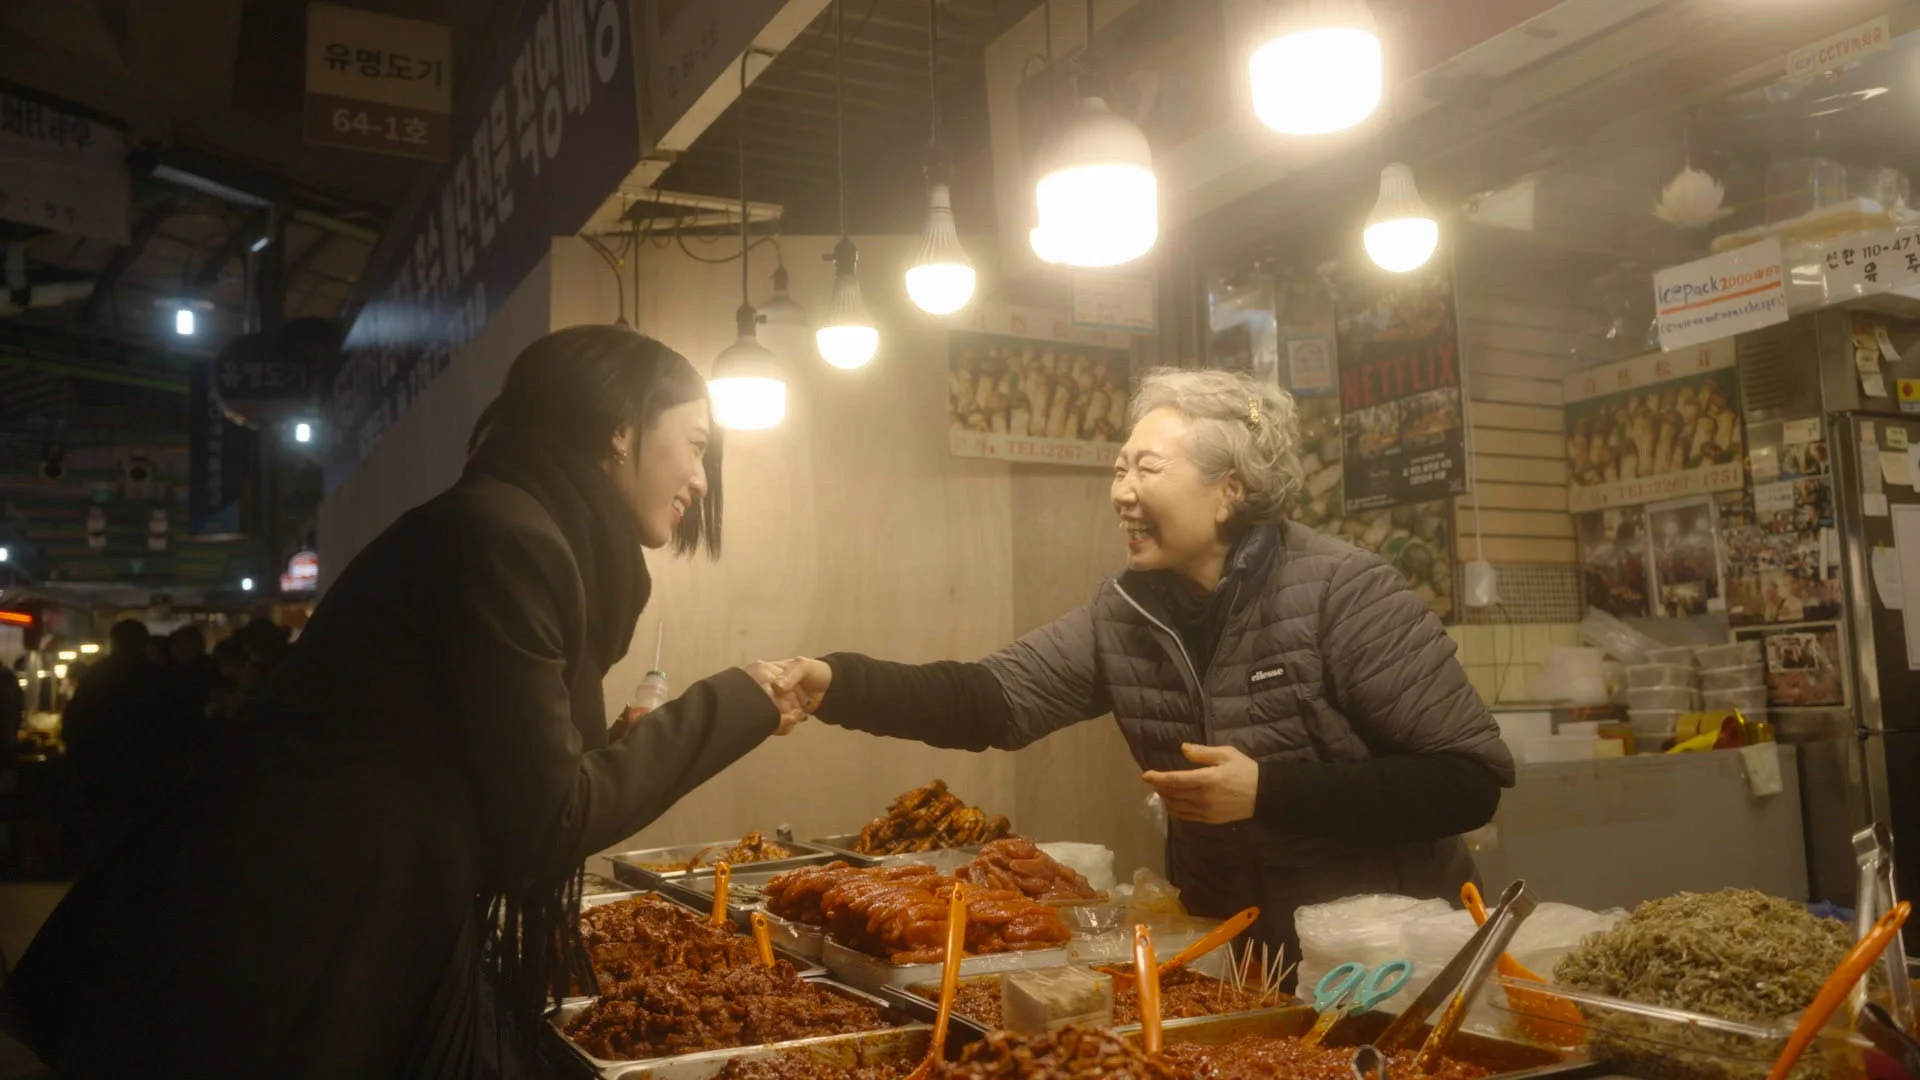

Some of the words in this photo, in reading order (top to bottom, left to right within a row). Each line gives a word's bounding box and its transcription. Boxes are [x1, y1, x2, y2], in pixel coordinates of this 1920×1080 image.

[323, 43, 442, 88] 유명도기
[332, 107, 430, 145] 64-1호
[472, 85, 515, 249] 전문
[1343, 340, 1456, 412] NETFLIX
[1250, 667, 1285, 682] ellesse
